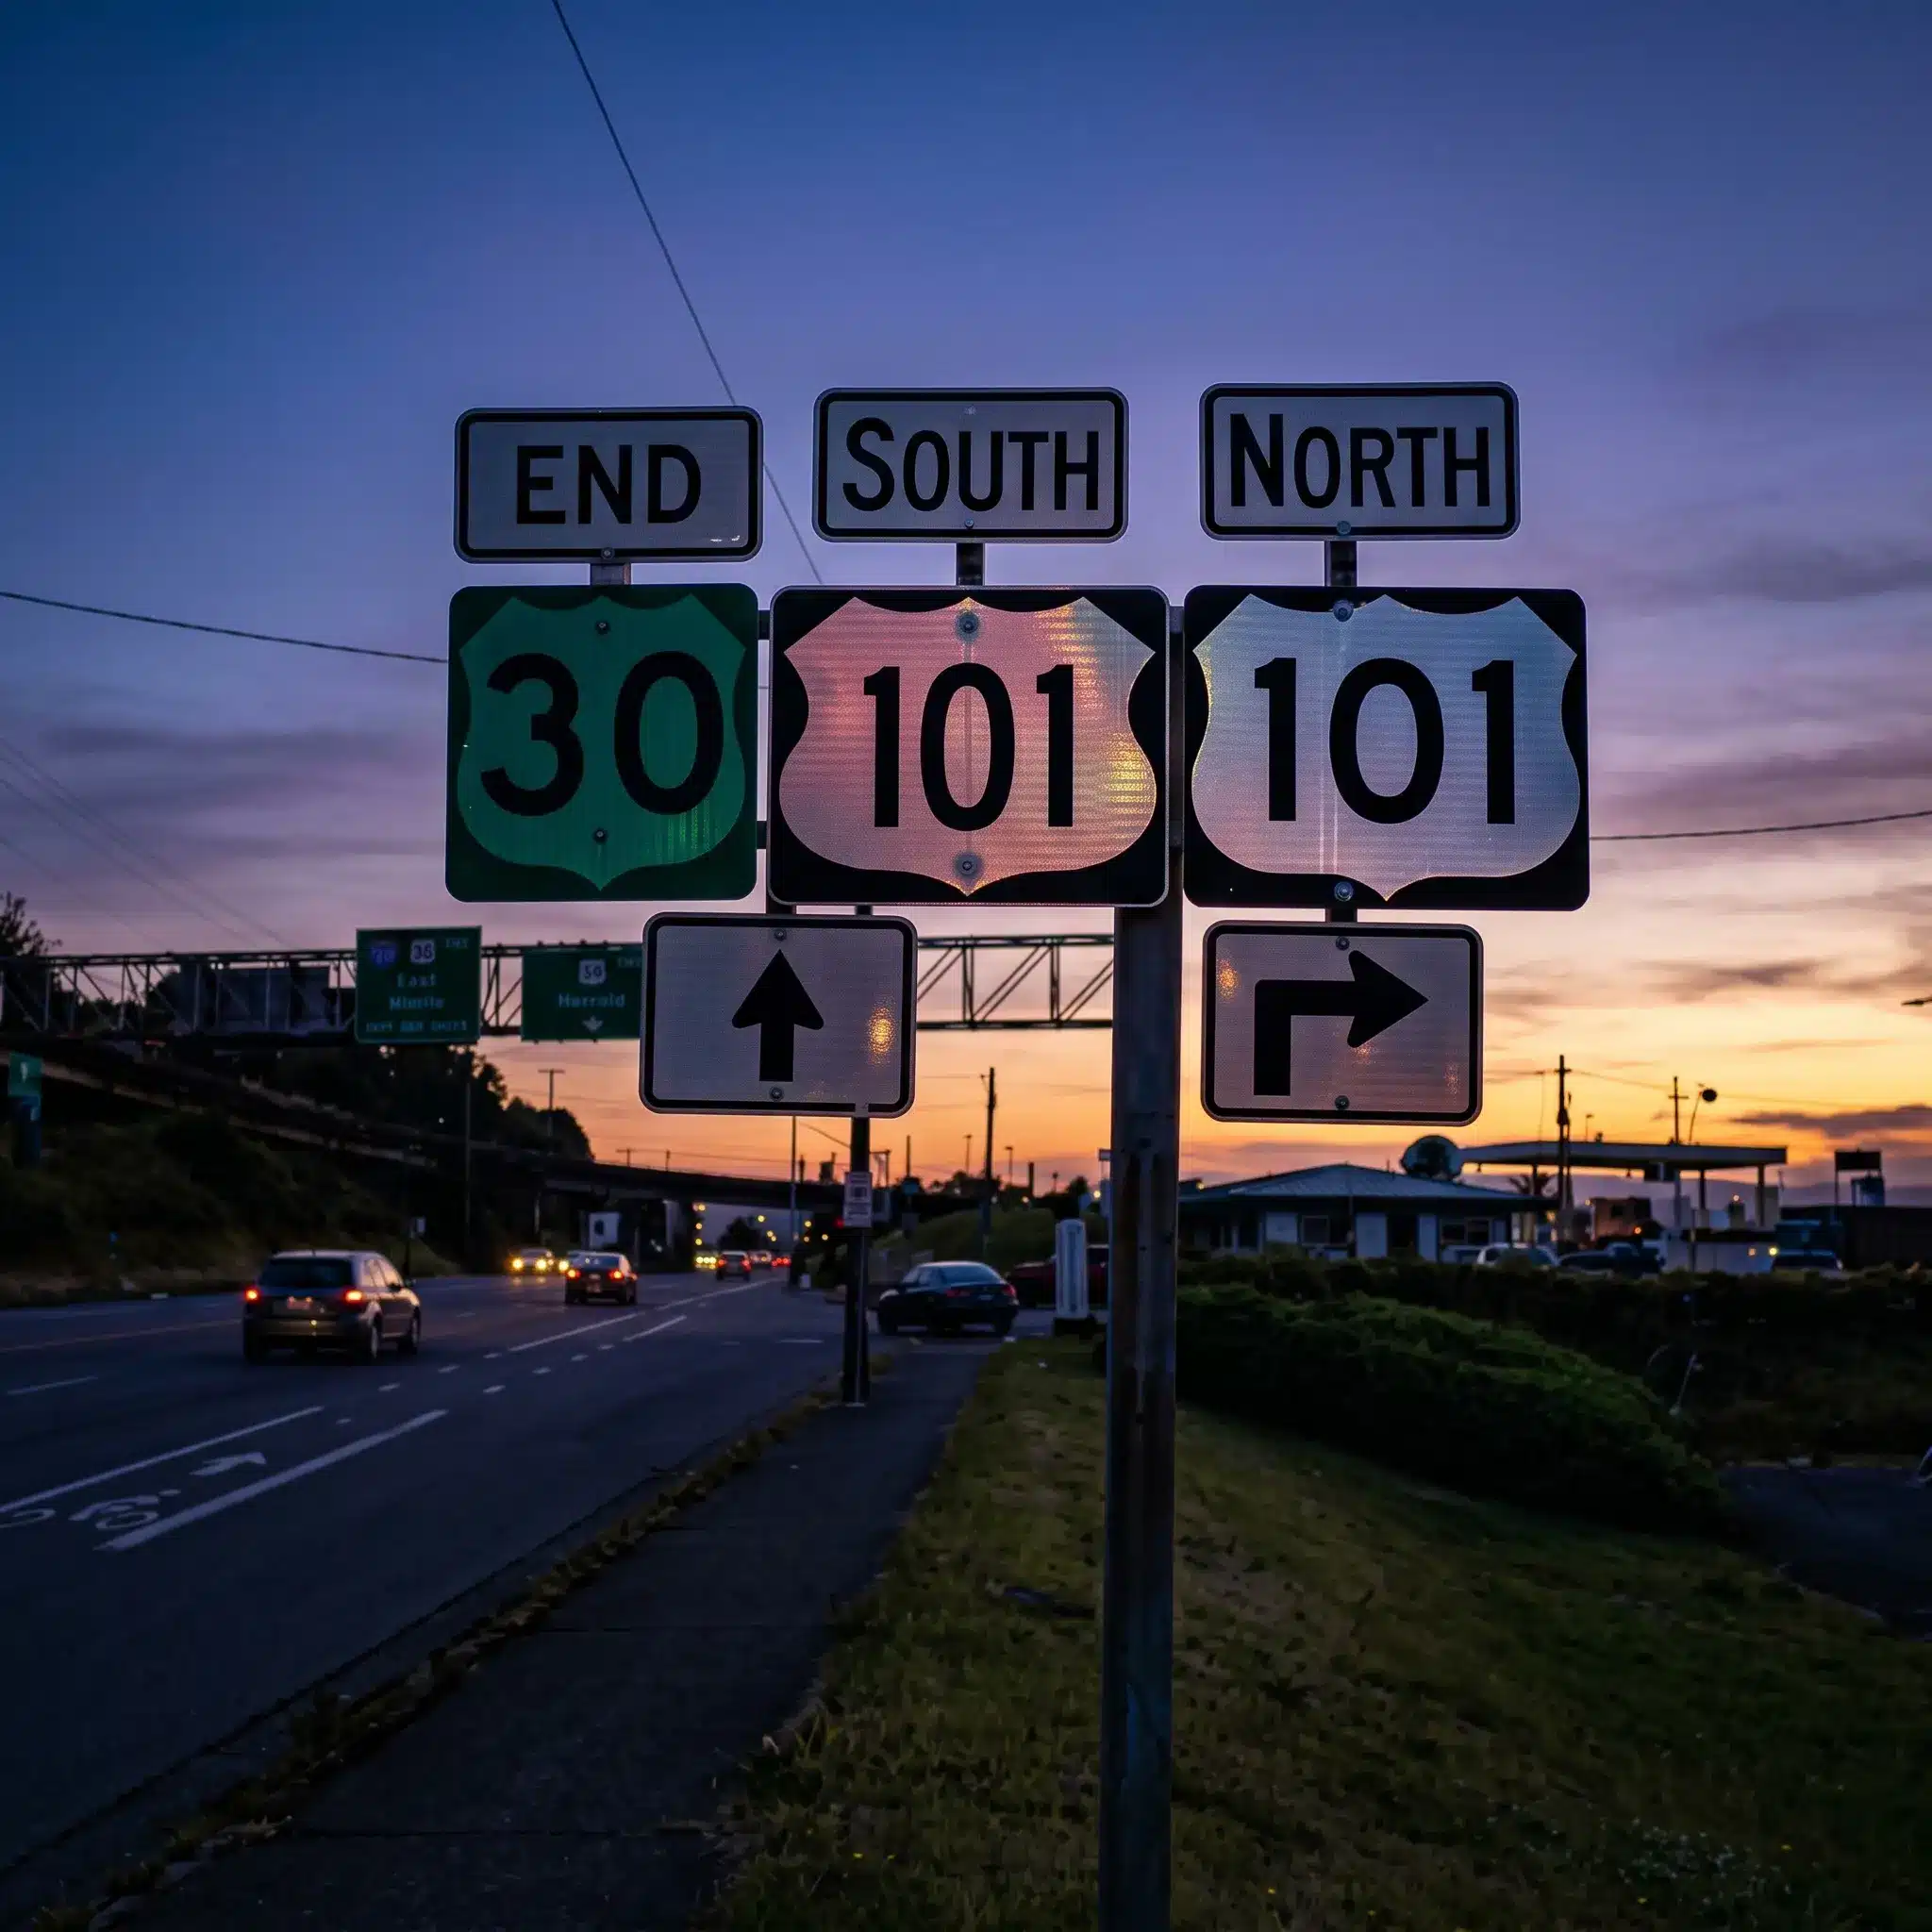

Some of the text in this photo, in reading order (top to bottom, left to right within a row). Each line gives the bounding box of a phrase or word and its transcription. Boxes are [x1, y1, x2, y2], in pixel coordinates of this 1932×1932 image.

[515, 443, 702, 525] END
[842, 417, 1099, 512] SOUTH
[1230, 413, 1490, 508] NORTH
[480, 650, 724, 817] 30
[863, 662, 1074, 832] 101
[1254, 657, 1516, 824] 101
